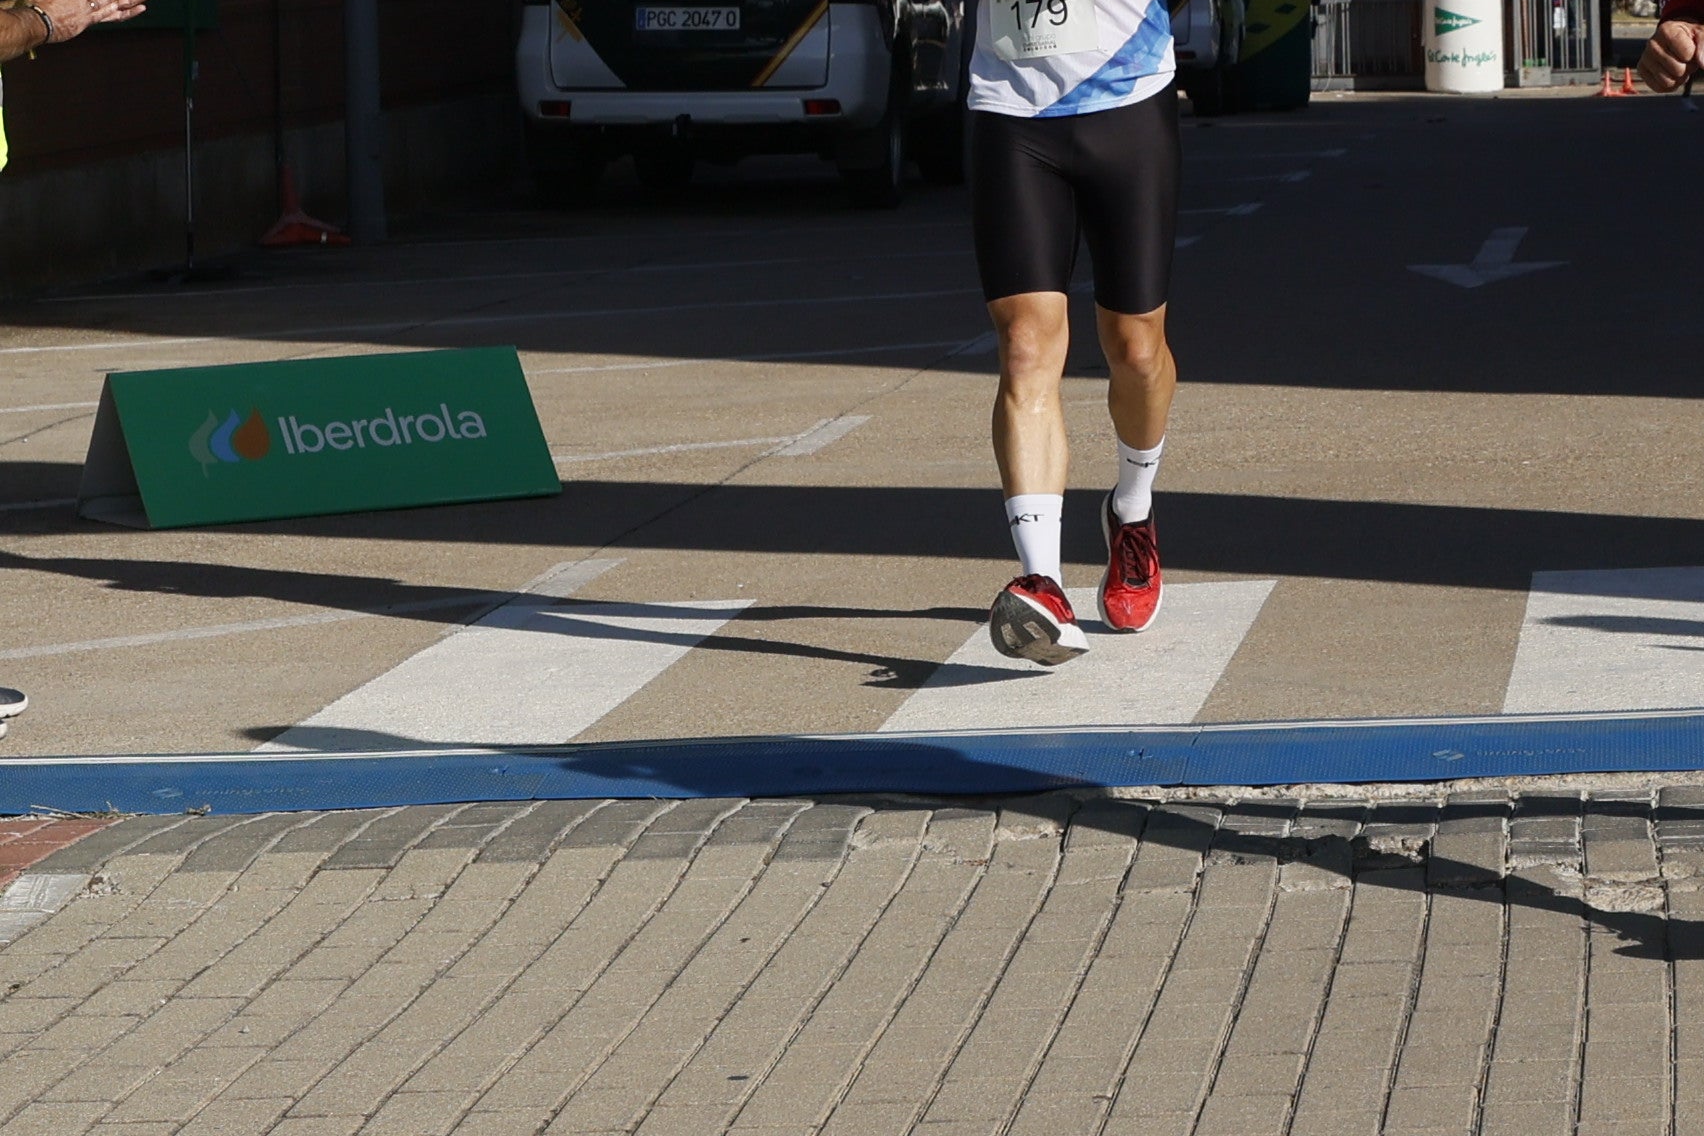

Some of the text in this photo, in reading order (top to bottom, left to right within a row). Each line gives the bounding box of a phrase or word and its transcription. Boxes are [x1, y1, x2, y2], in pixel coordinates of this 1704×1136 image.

[647, 10, 677, 27] PGC
[681, 10, 722, 27] 2047
[278, 403, 487, 454] Iberdrola
